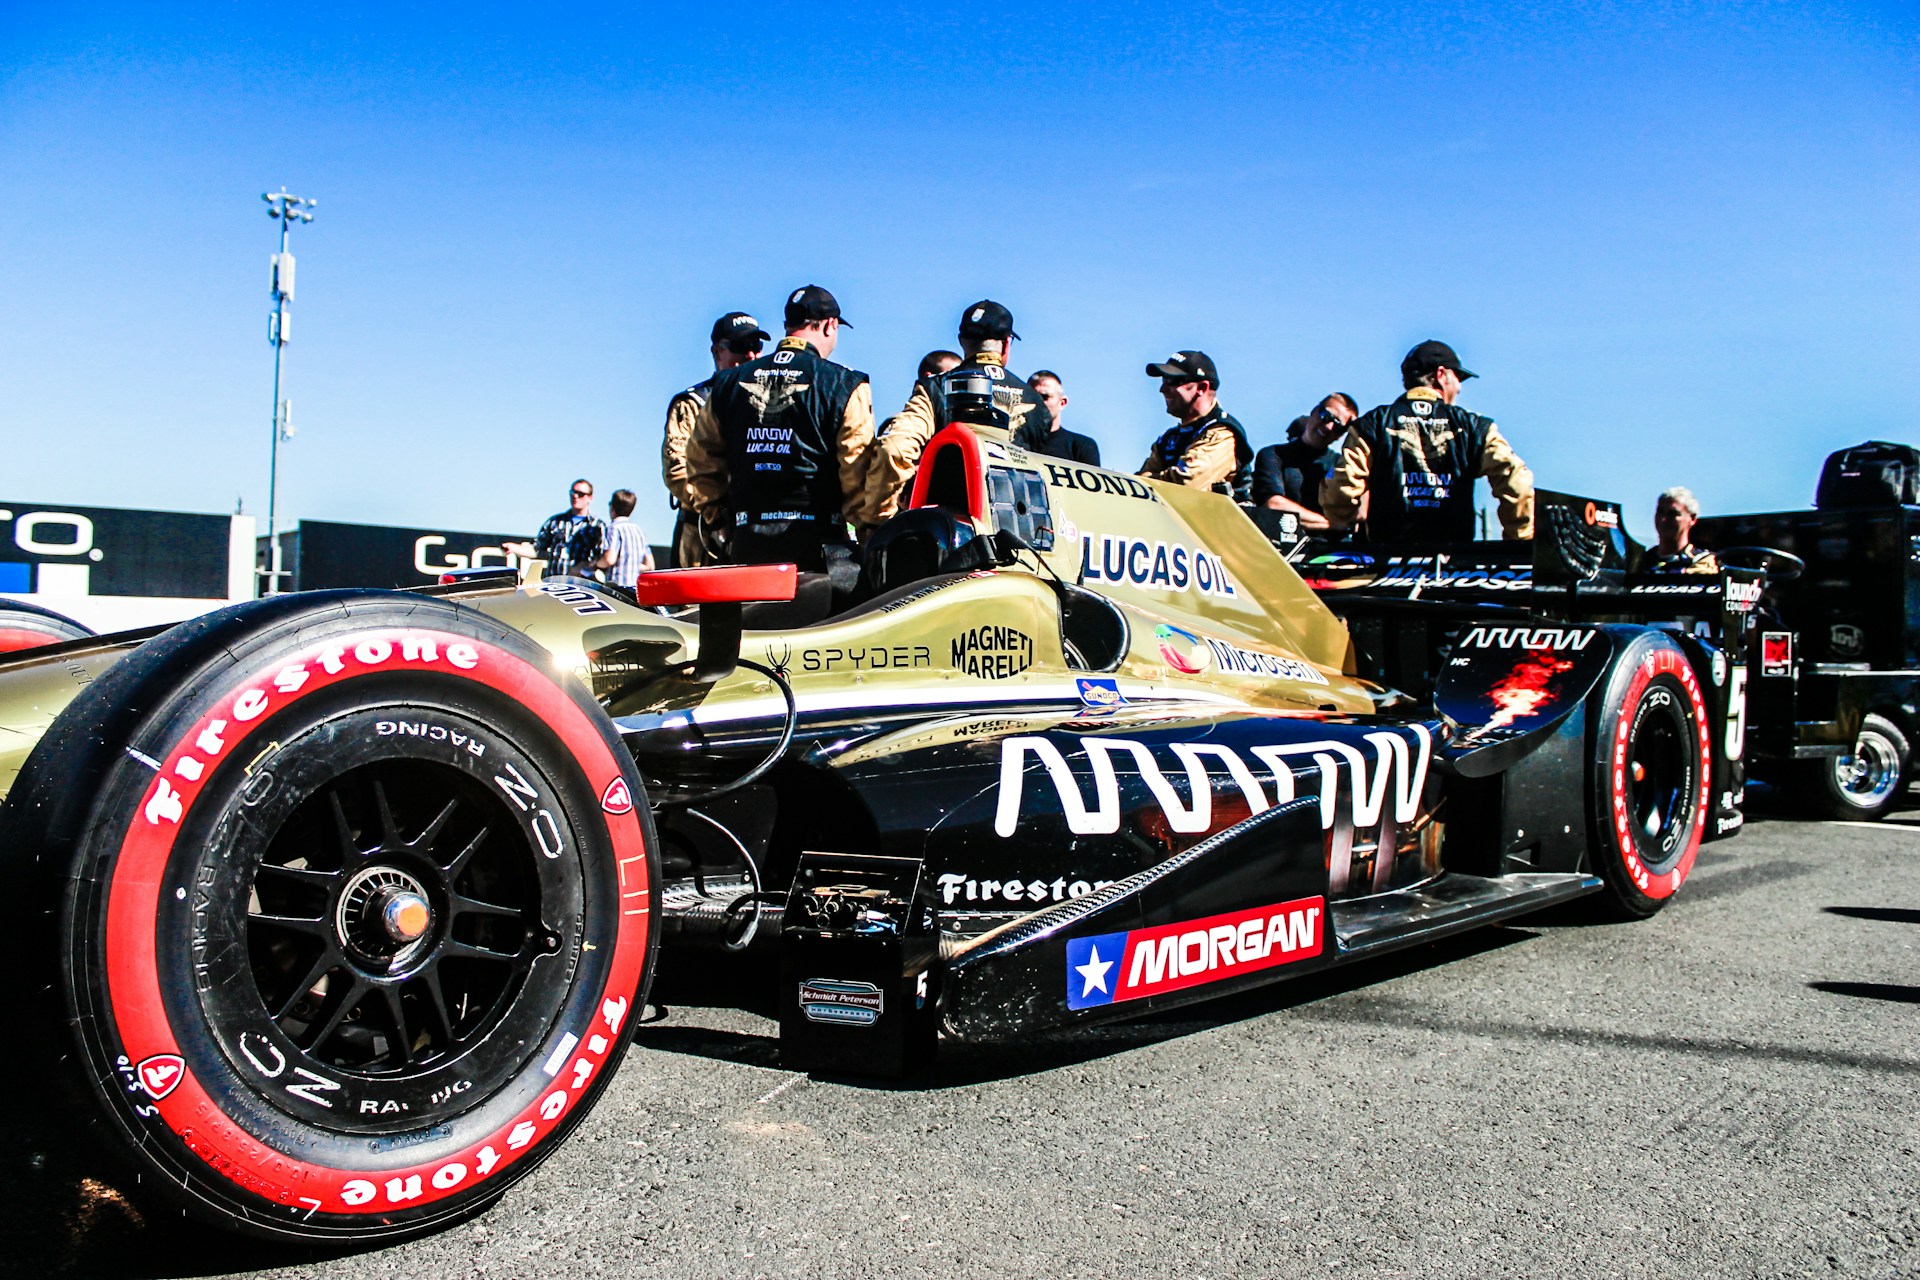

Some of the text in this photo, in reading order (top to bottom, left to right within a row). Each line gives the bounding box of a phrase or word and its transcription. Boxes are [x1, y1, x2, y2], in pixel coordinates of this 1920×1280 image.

[746, 443, 792, 454] LUCAS OIL
[747, 428, 793, 441] ARROW
[1082, 535, 1235, 595] LUCAS OIL
[536, 583, 618, 616] LUC
[952, 626, 1033, 654] MAGNETI
[1459, 627, 1597, 651] ARROW
[803, 646, 931, 671] SPYDER
[952, 653, 1033, 680] MARELLI
[1086, 692, 1118, 700] SUNOCO
[145, 636, 480, 824] Firestone
[375, 721, 486, 757] RACING
[995, 723, 1432, 837] ARROW
[937, 873, 1115, 905] Firesto
[1127, 907, 1316, 988] MORGAN
[803, 990, 880, 1005] Schmidt Peterson
[340, 996, 628, 1206] Firestone
